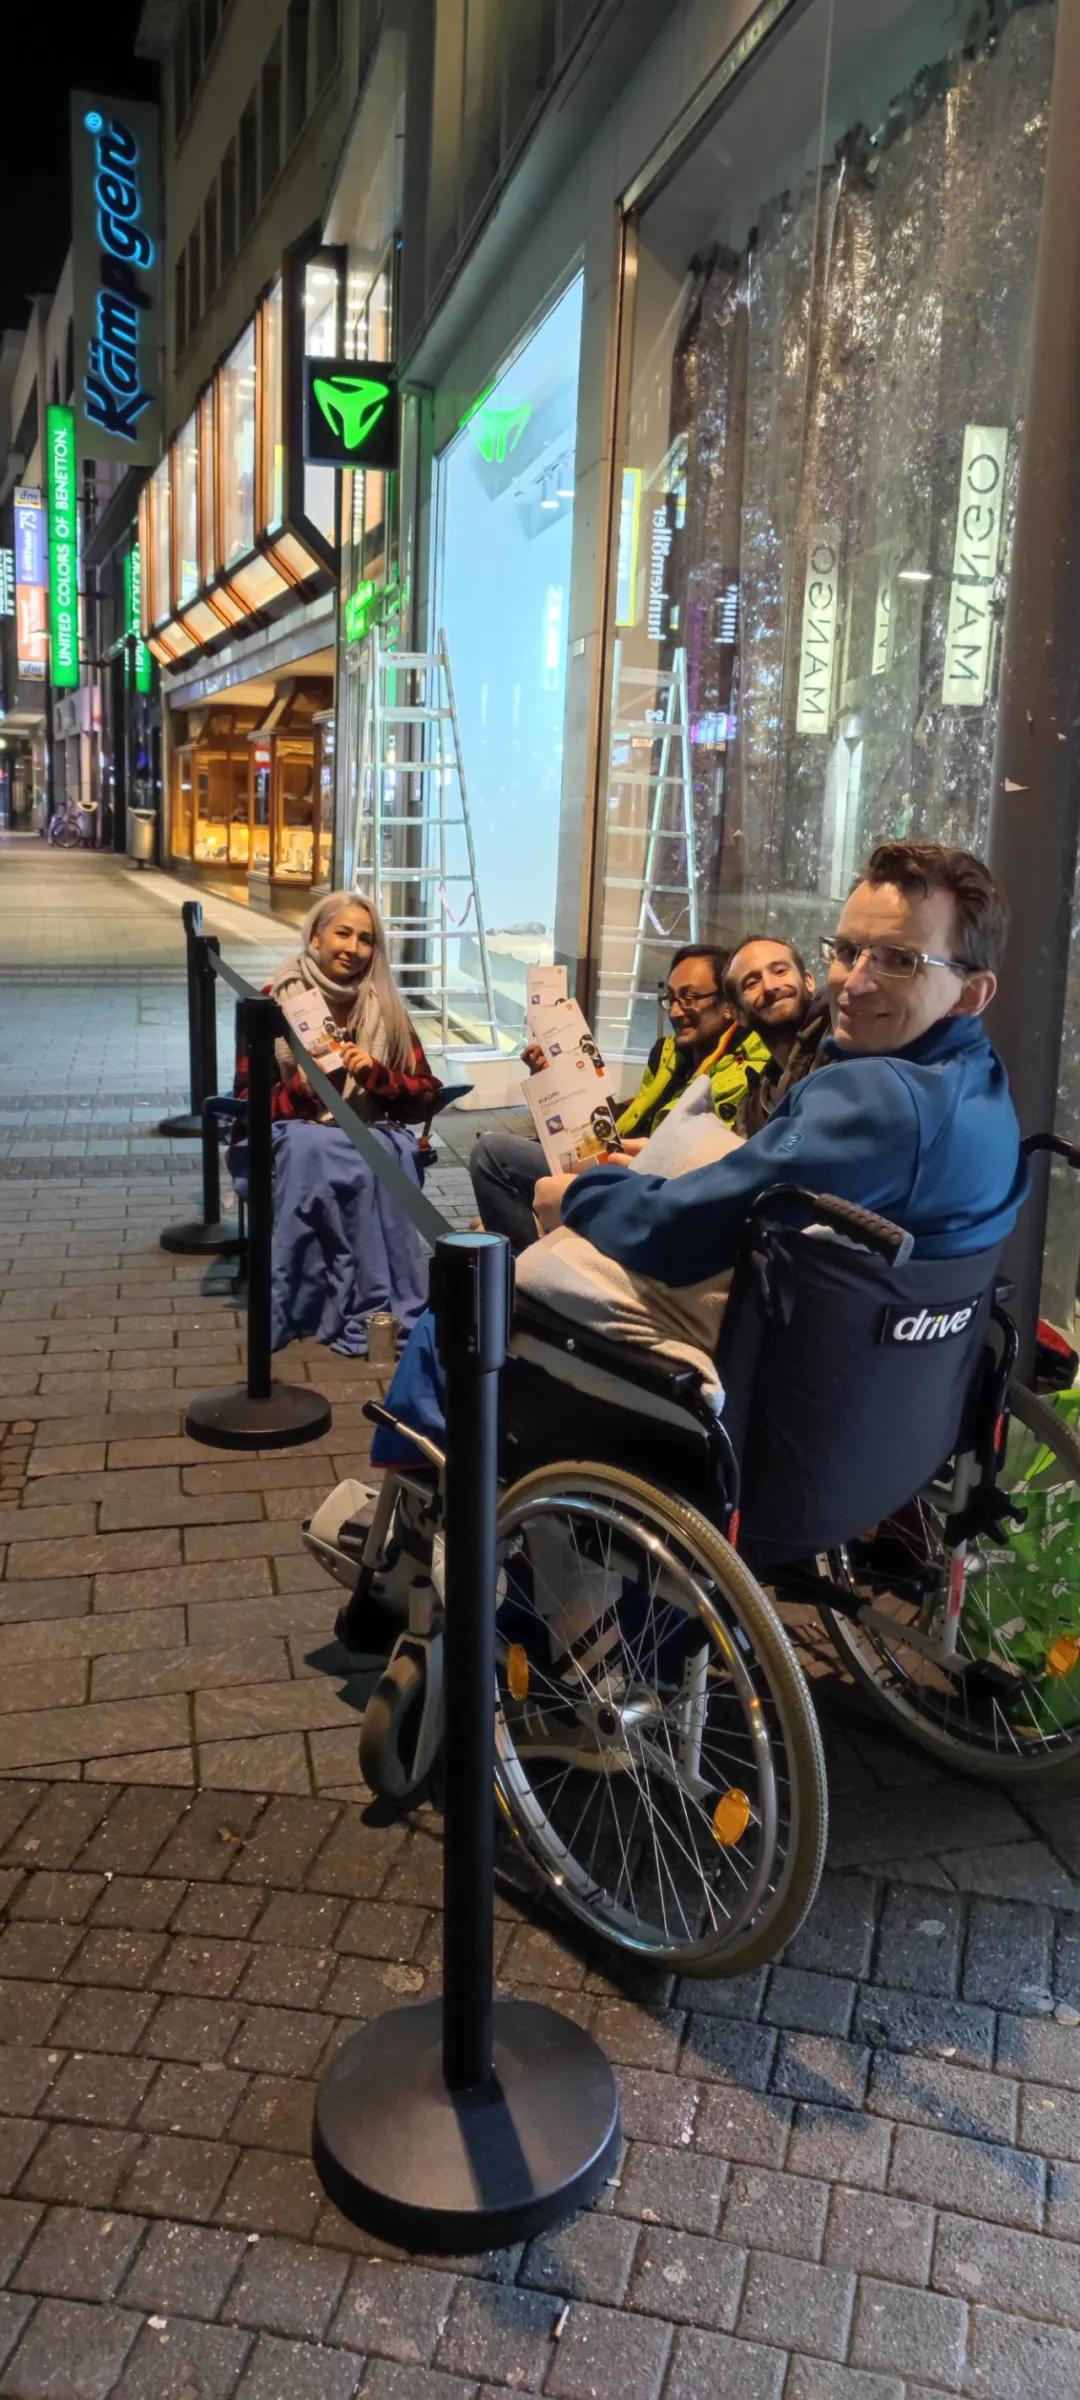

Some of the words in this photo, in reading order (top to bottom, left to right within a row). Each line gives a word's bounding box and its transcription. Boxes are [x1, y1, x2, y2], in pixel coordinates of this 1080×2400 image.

[85, 116, 154, 442] Kämpgen
[55, 516, 69, 538] OF
[57, 543, 71, 606] COLORS
[58, 612, 72, 667] UNITED
[892, 1307, 973, 1341] drive
